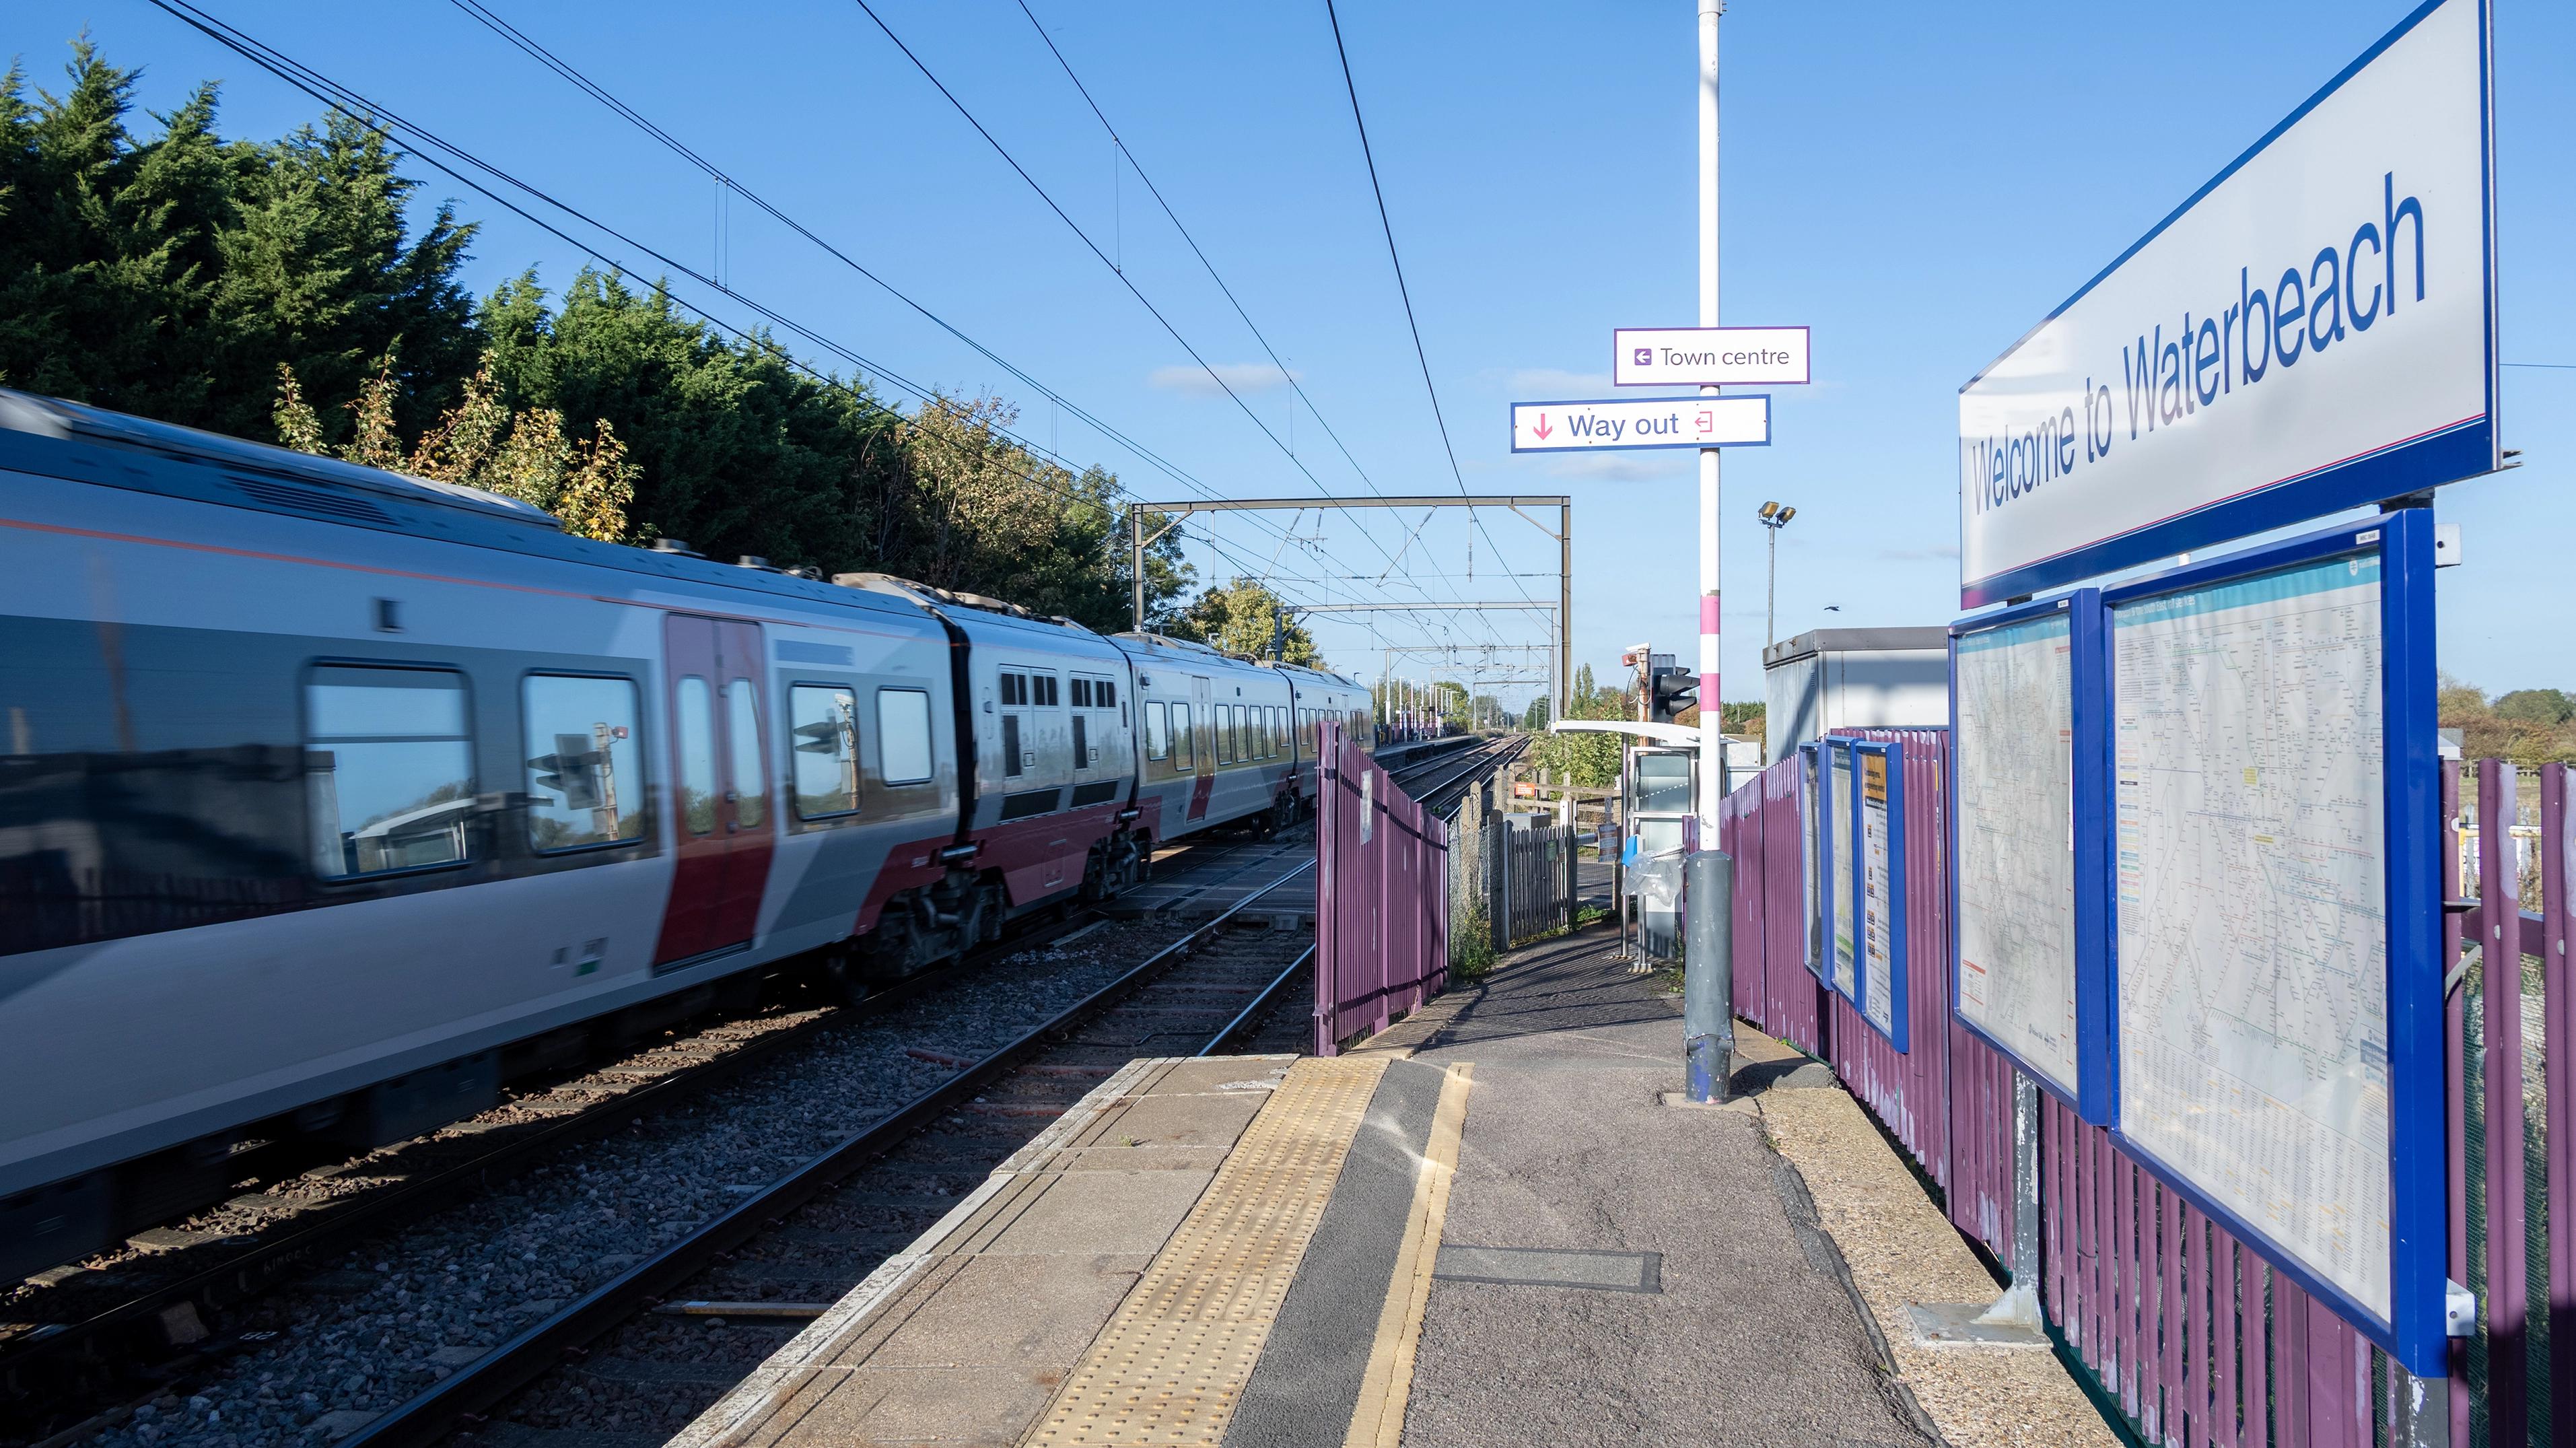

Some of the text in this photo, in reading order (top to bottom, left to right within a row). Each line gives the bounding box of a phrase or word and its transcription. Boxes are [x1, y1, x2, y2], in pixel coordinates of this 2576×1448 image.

[1661, 348, 1789, 365] Town centre
[1973, 171, 2425, 516] Welcome to Waterbeach
[1568, 413, 1679, 442] Way out
